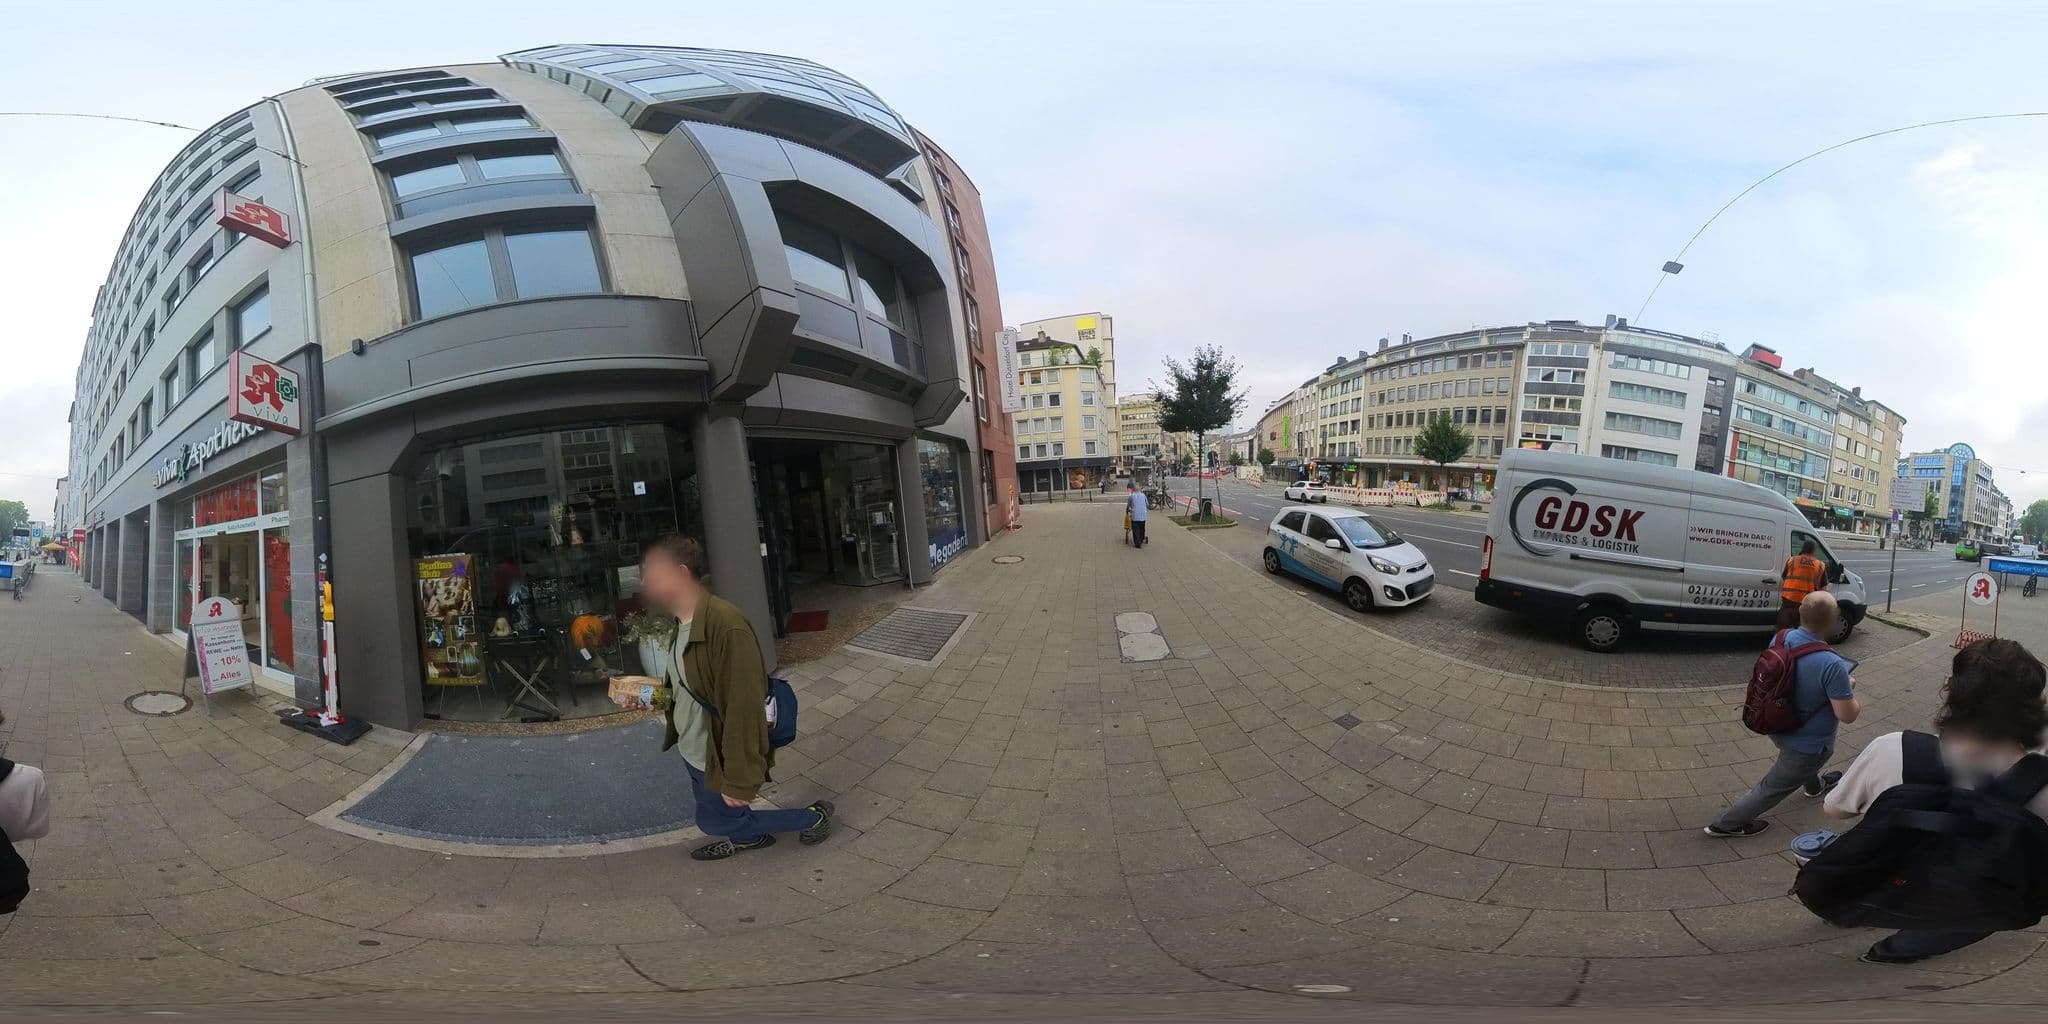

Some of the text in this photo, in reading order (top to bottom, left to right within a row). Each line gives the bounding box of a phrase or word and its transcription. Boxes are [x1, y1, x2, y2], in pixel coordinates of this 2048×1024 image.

[1006, 380, 1015, 399] Hotel
[1535, 496, 1646, 542] GDSK
[1533, 529, 1640, 554] EXPRESS & LOGISTIK
[1715, 529, 1750, 540] BRINGEN
[1688, 535, 1772, 549] www.GDSK-express.de
[1688, 585, 1771, 599] 0211/58 05 010
[1693, 596, 1770, 608] 0541/91 22 20
[220, 655, 242, 666] 10%
[220, 670, 242, 680] Alles
